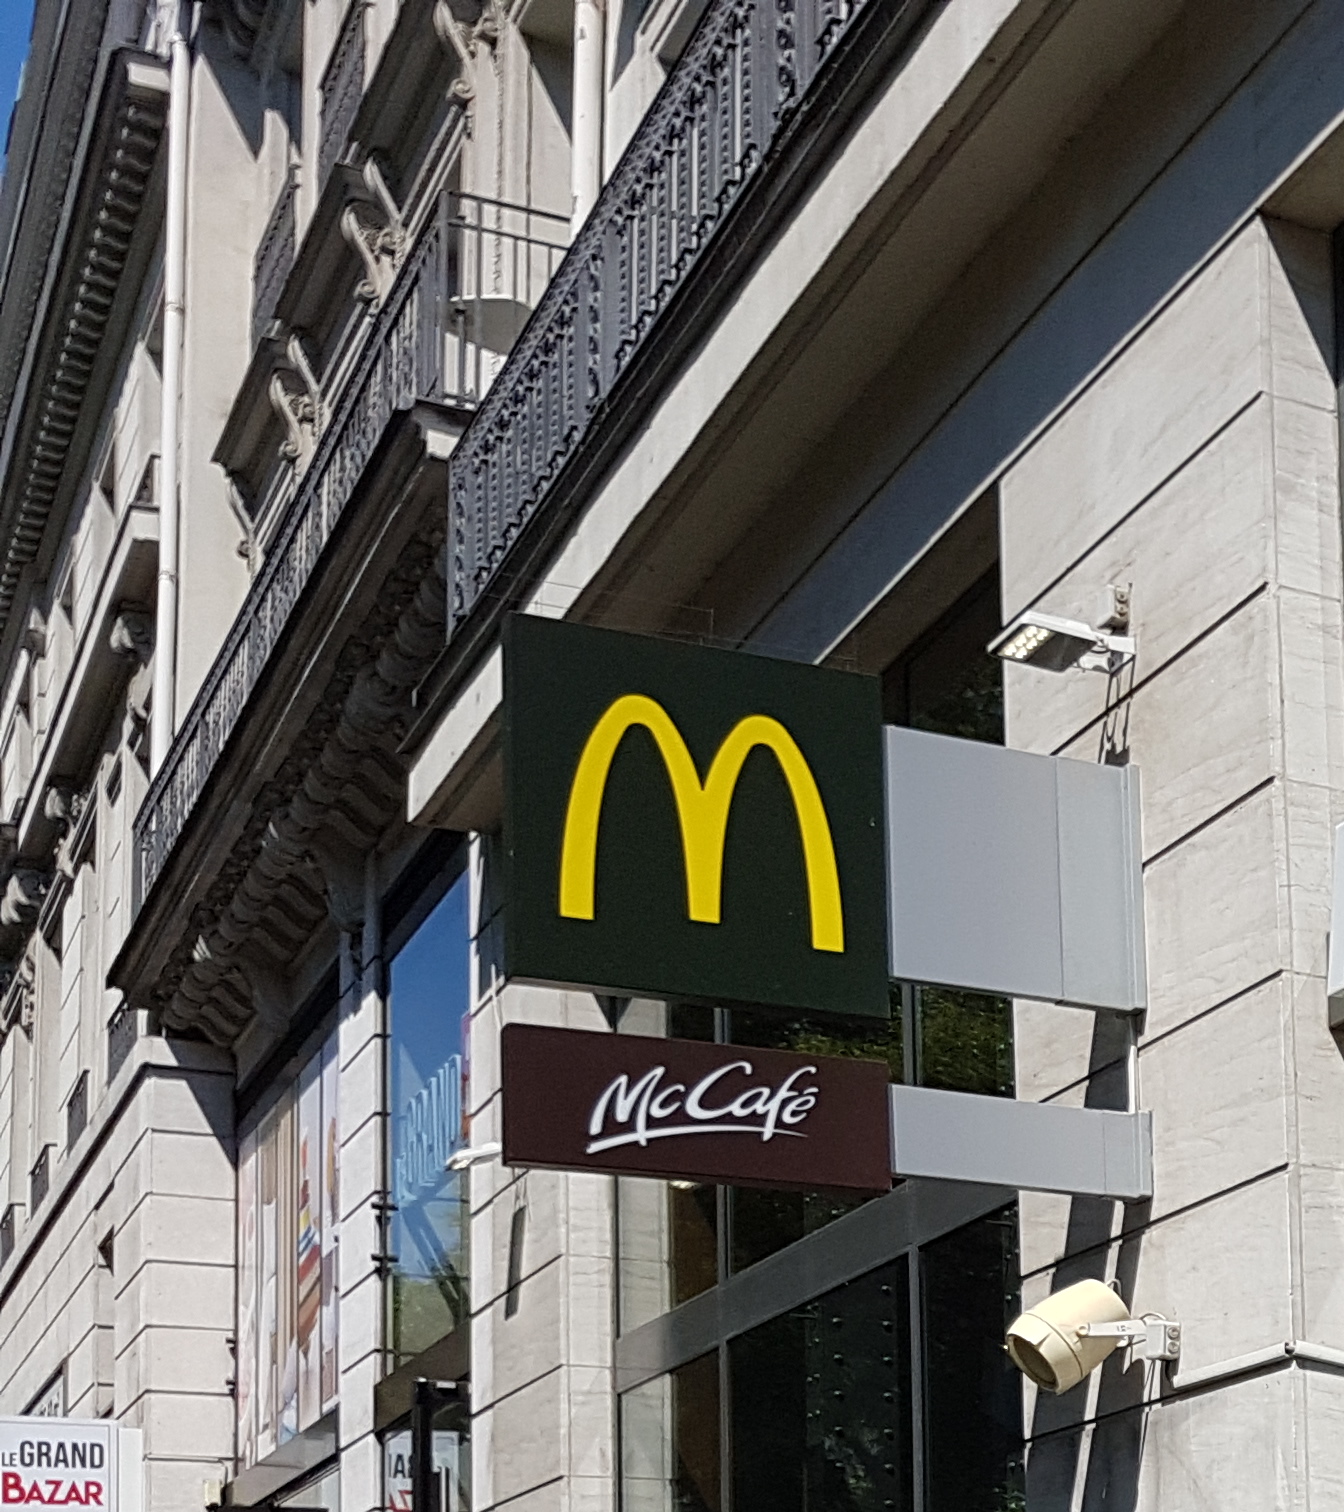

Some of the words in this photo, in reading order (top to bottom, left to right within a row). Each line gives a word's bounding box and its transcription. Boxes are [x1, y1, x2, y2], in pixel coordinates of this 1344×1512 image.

[586, 1060, 820, 1150] McCafé
[1, 1452, 17, 1468] LE
[19, 1440, 105, 1469] GRAND
[1, 1471, 104, 1506] BAZAR
